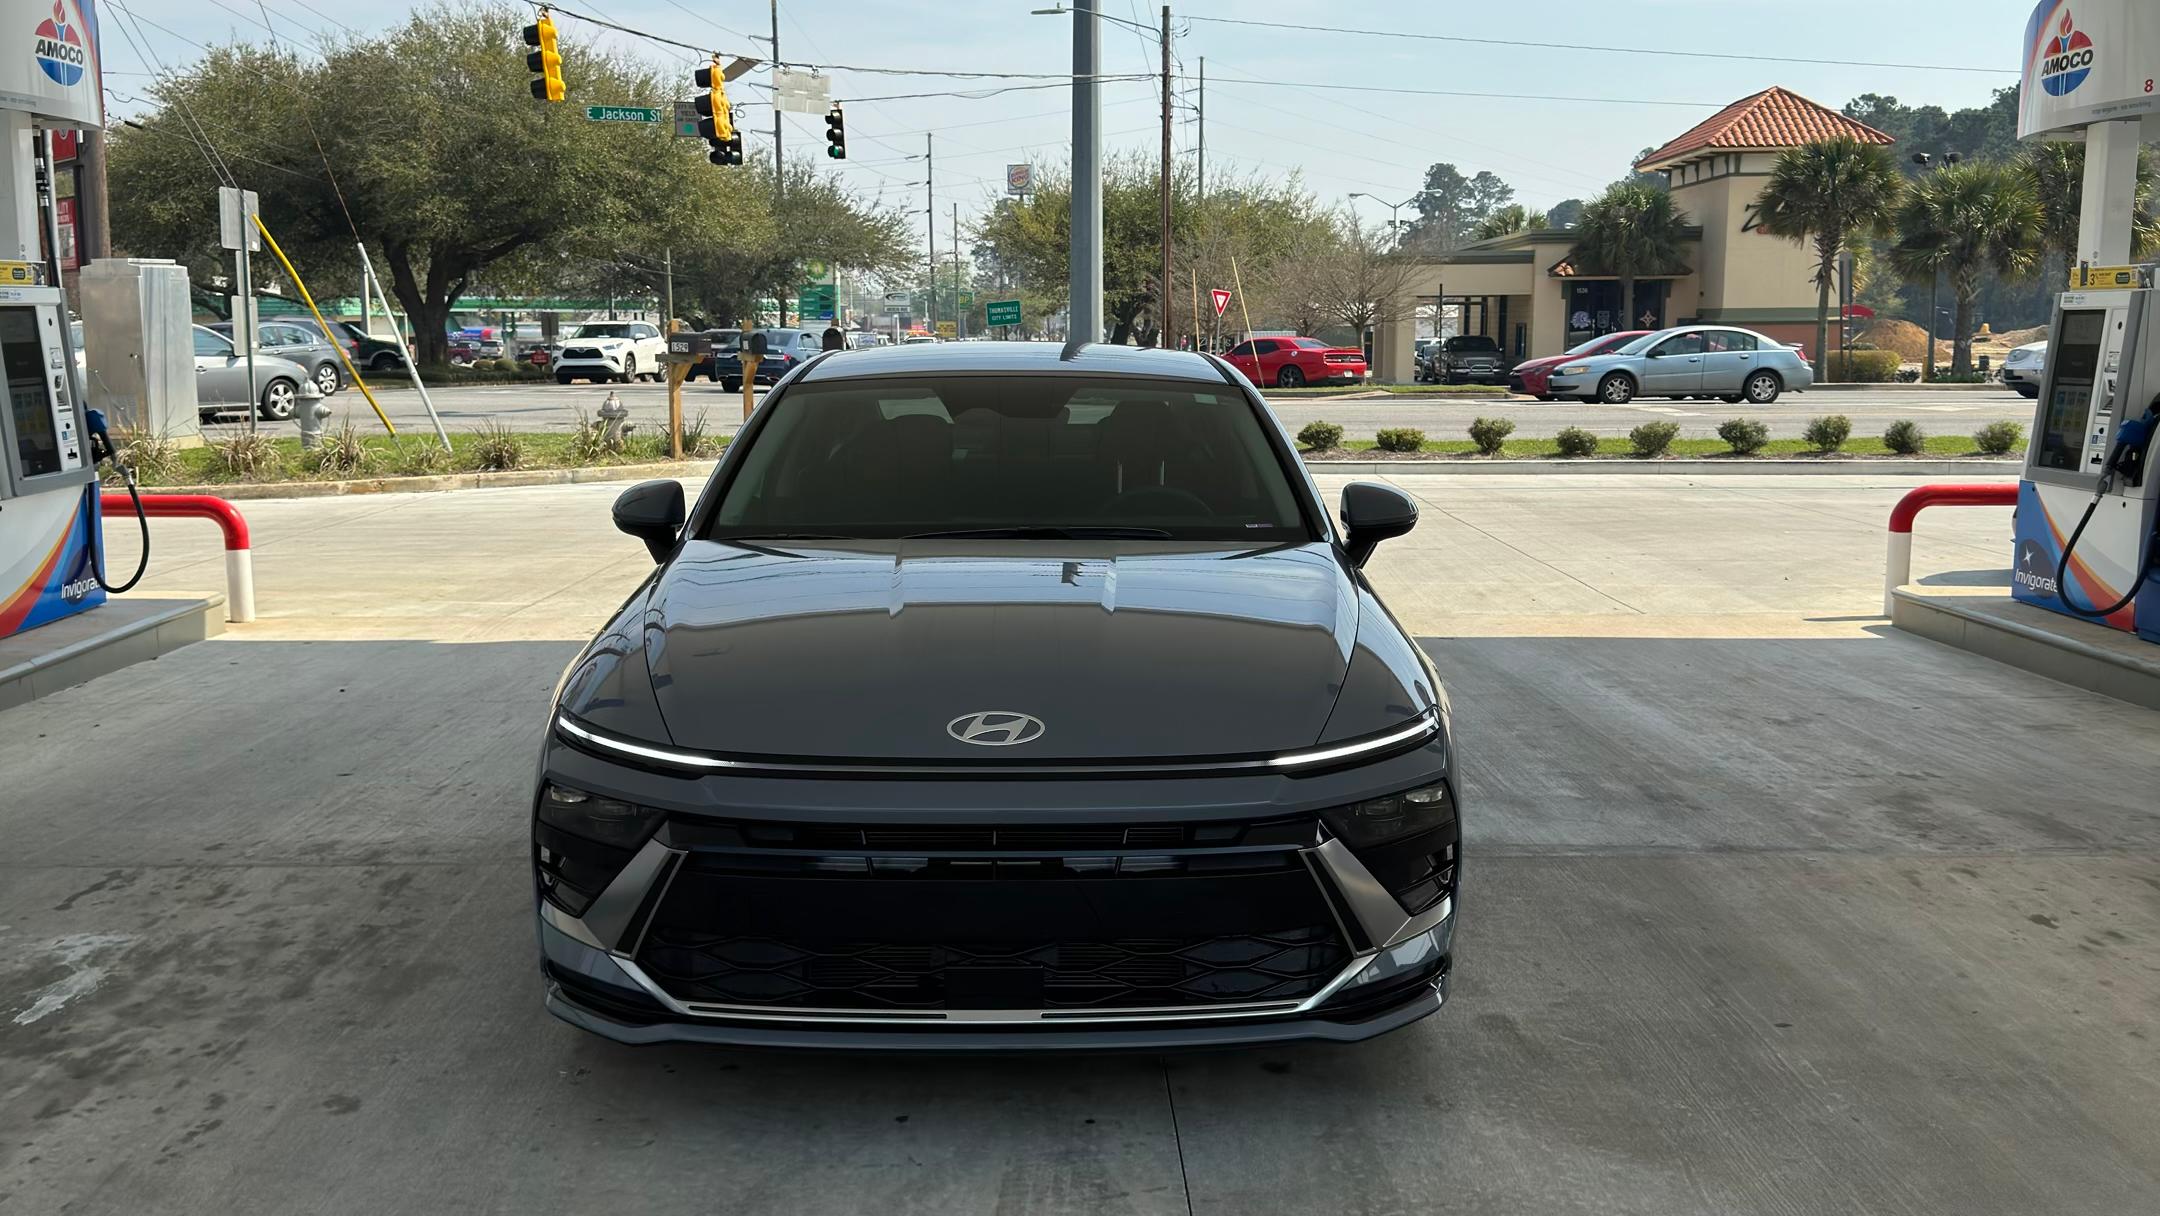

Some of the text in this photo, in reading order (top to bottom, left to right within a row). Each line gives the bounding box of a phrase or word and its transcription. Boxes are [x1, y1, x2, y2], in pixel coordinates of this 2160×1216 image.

[35, 39, 83, 65] AMOCO
[2041, 49, 2093, 76] AMOCO
[2144, 79, 2153, 93] 8
[586, 108, 661, 122] E Jackson St
